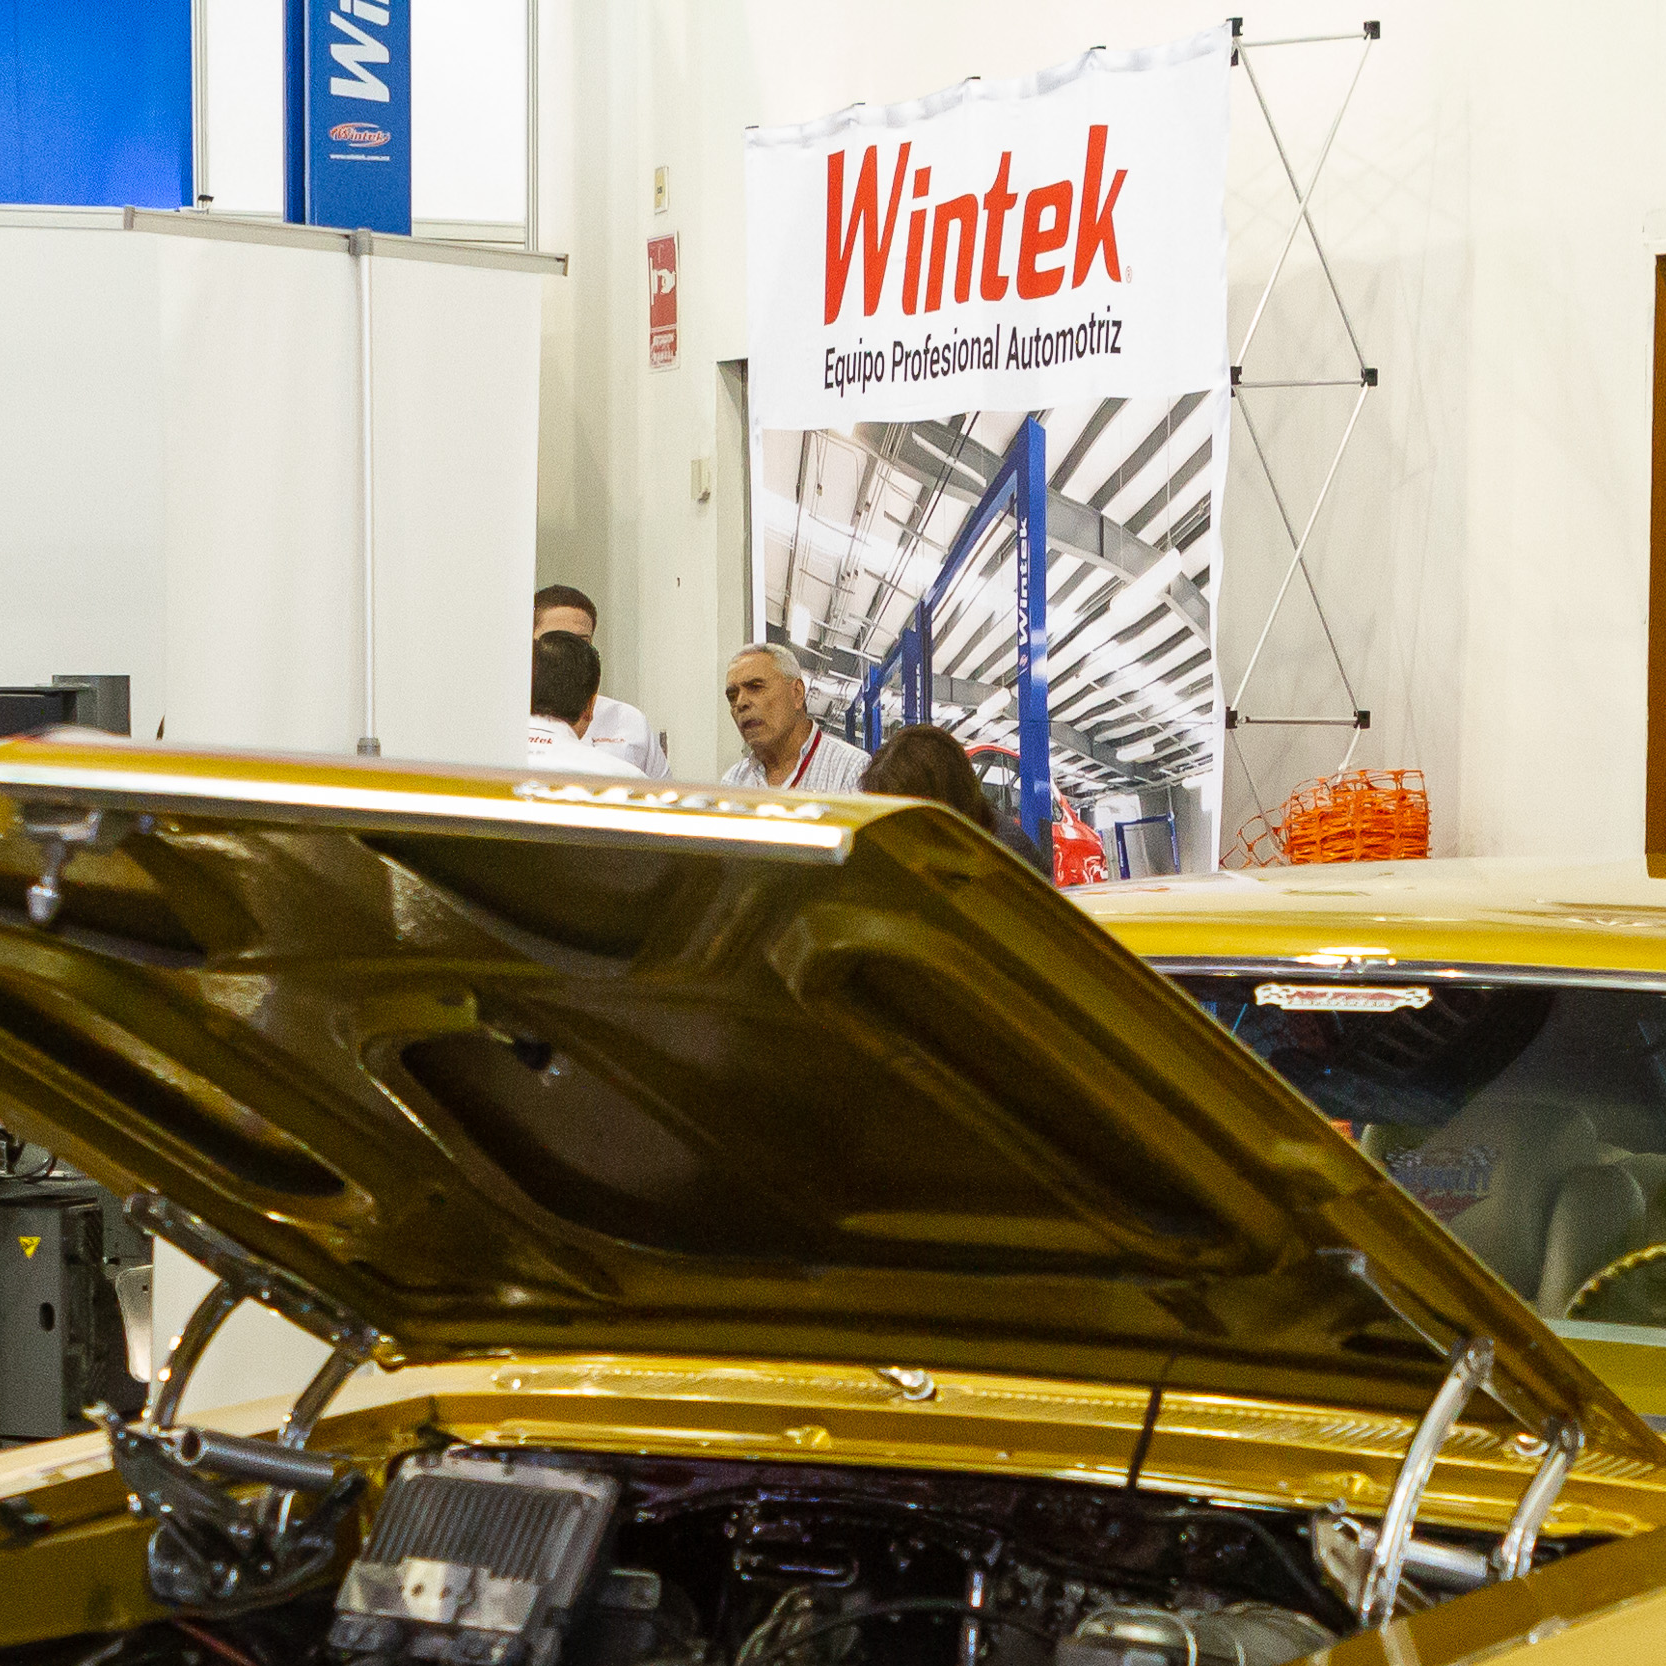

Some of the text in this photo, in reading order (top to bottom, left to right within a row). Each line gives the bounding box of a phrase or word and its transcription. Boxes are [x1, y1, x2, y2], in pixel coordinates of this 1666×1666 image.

[824, 124, 1128, 326] Wintek
[825, 305, 1123, 397] Equipo Profesional Automotriz
